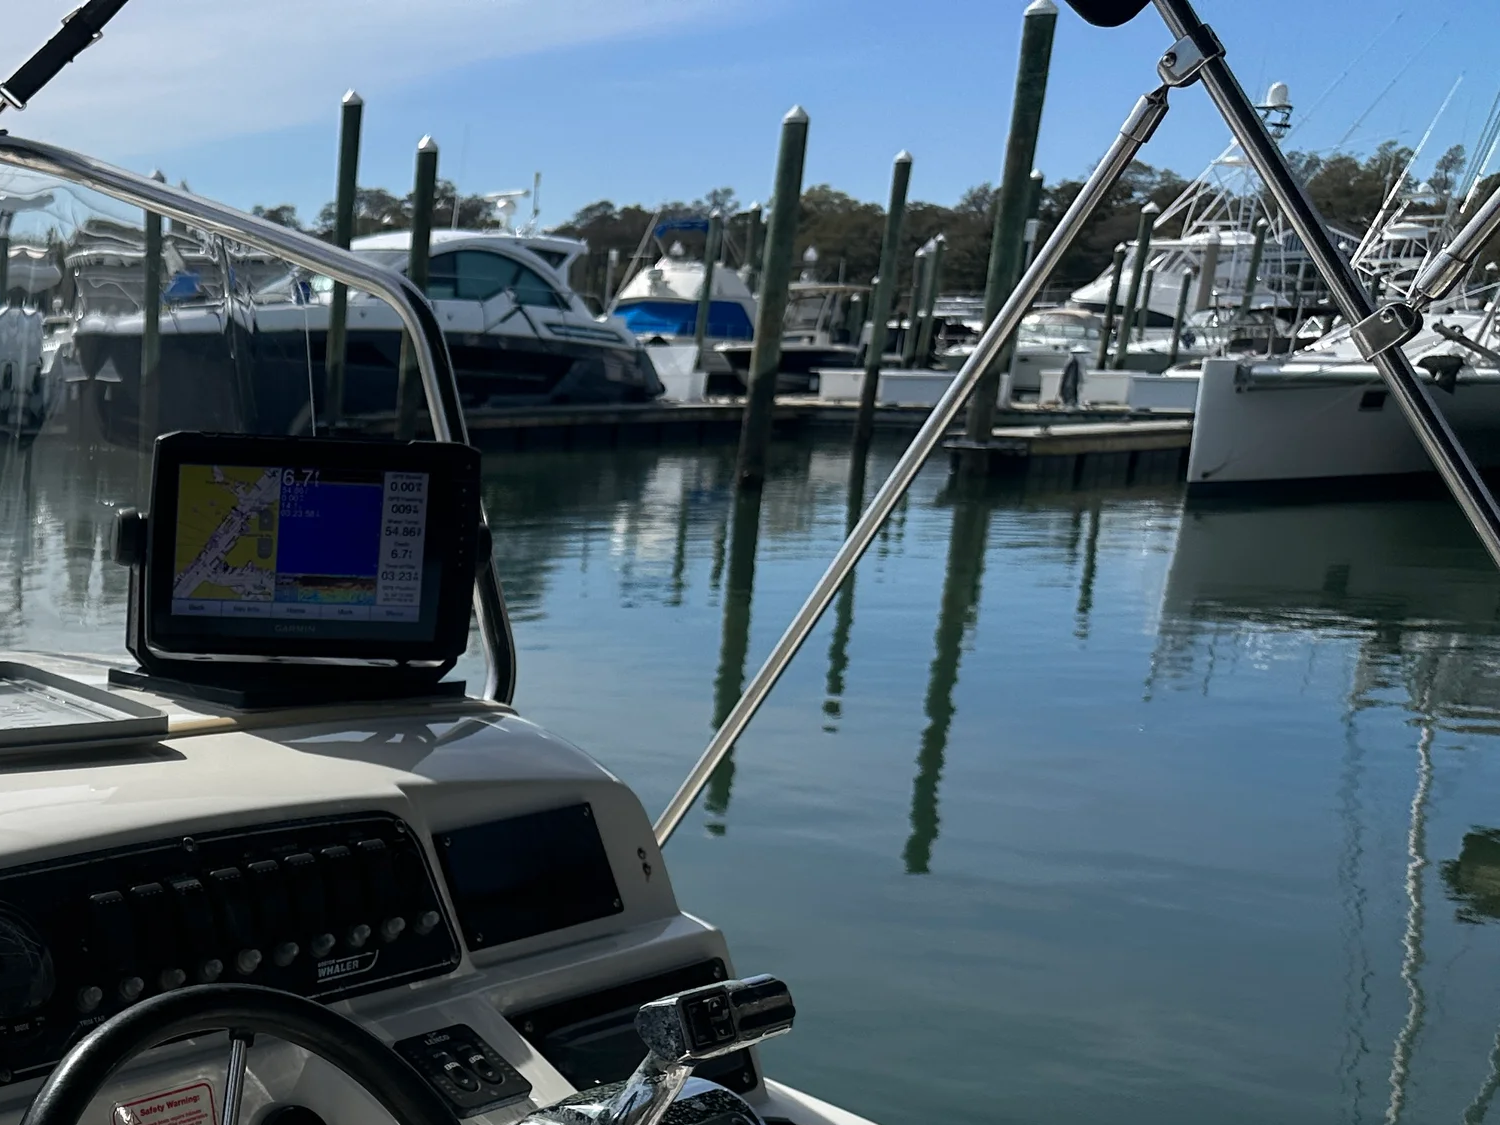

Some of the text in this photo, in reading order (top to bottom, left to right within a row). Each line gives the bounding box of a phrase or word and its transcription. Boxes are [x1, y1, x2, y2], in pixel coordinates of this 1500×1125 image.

[274, 624, 316, 633] GARMIN
[318, 960, 360, 978] WHALER
[140, 1095, 200, 1116] Safety Warning:
